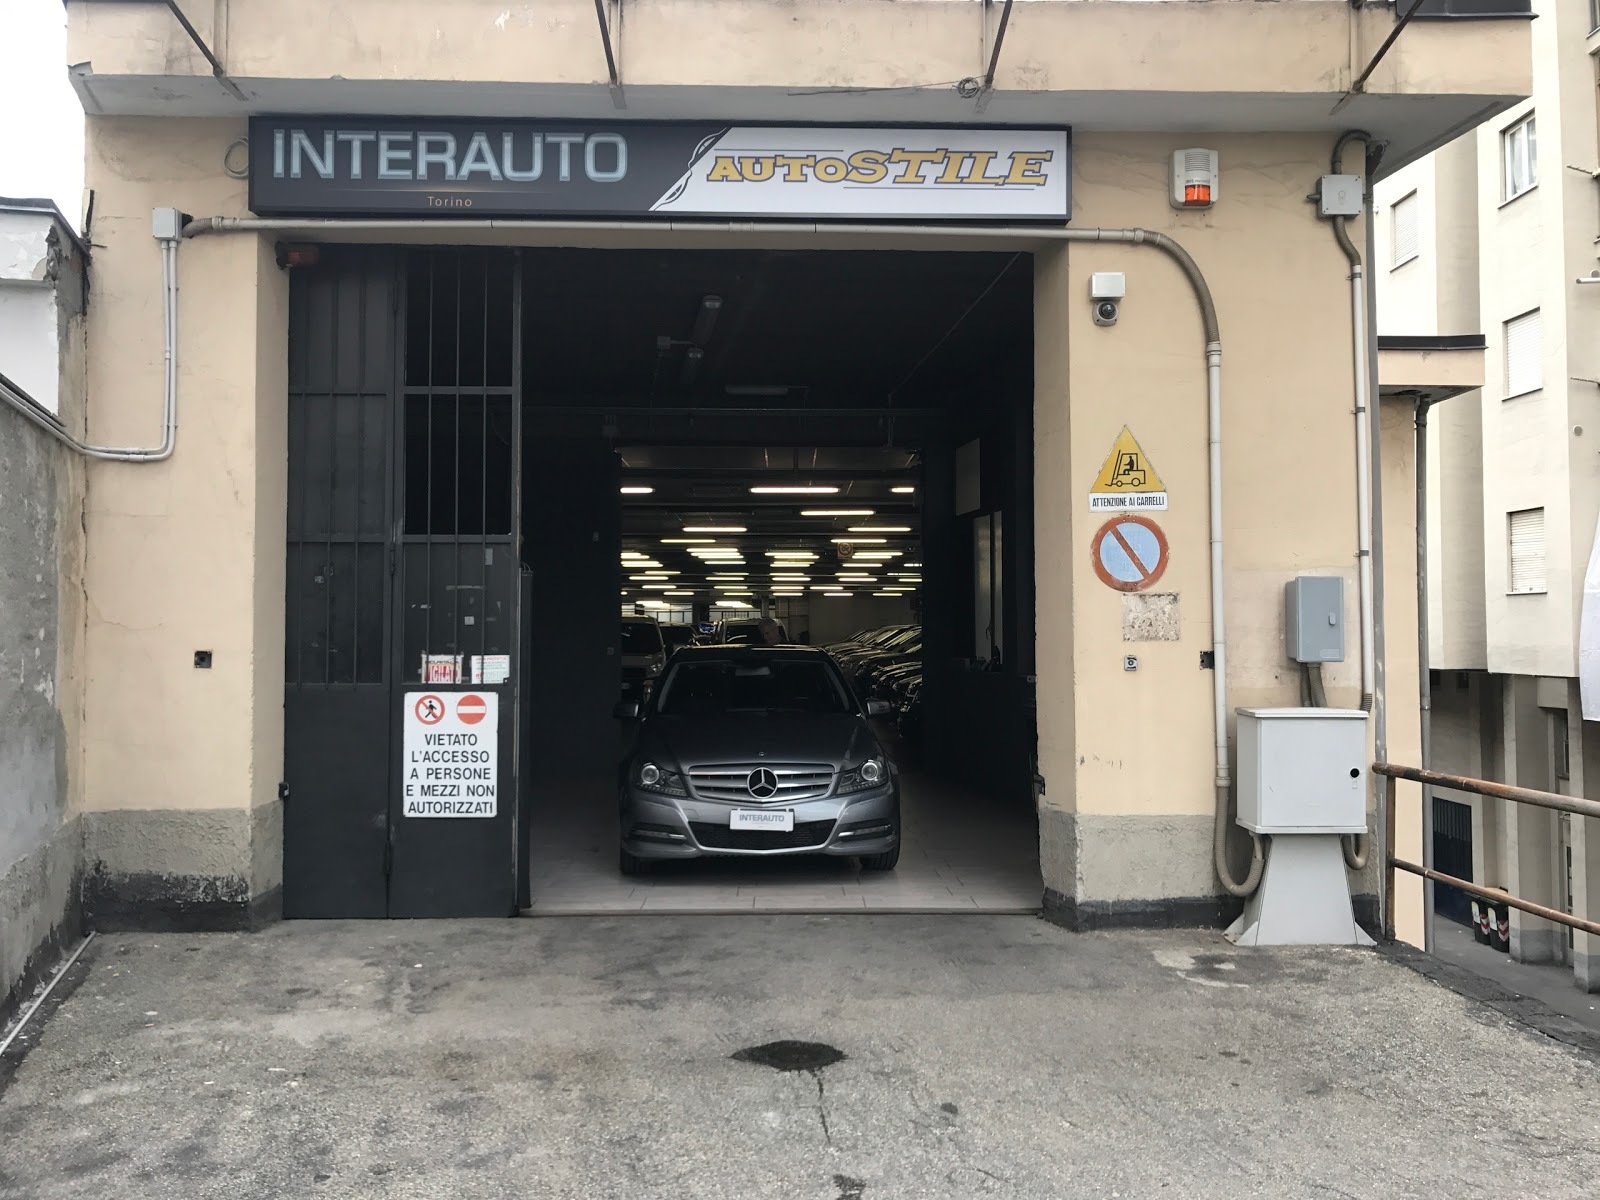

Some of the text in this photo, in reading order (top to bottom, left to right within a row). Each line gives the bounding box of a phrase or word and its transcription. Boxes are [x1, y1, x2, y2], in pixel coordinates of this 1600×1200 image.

[273, 128, 628, 182] INTERAUTO
[427, 196, 473, 207] Torino
[1092, 496, 1165, 507] ATTENZIONE AI CARRELLI
[424, 733, 478, 746] VIETATO
[411, 750, 490, 763] L'ACCESSO
[410, 767, 491, 780] A PERSONE
[406, 785, 495, 797] E MEZZI NON
[408, 801, 493, 814] AUTORIZZATI
[739, 814, 785, 822] INTERAUTO
